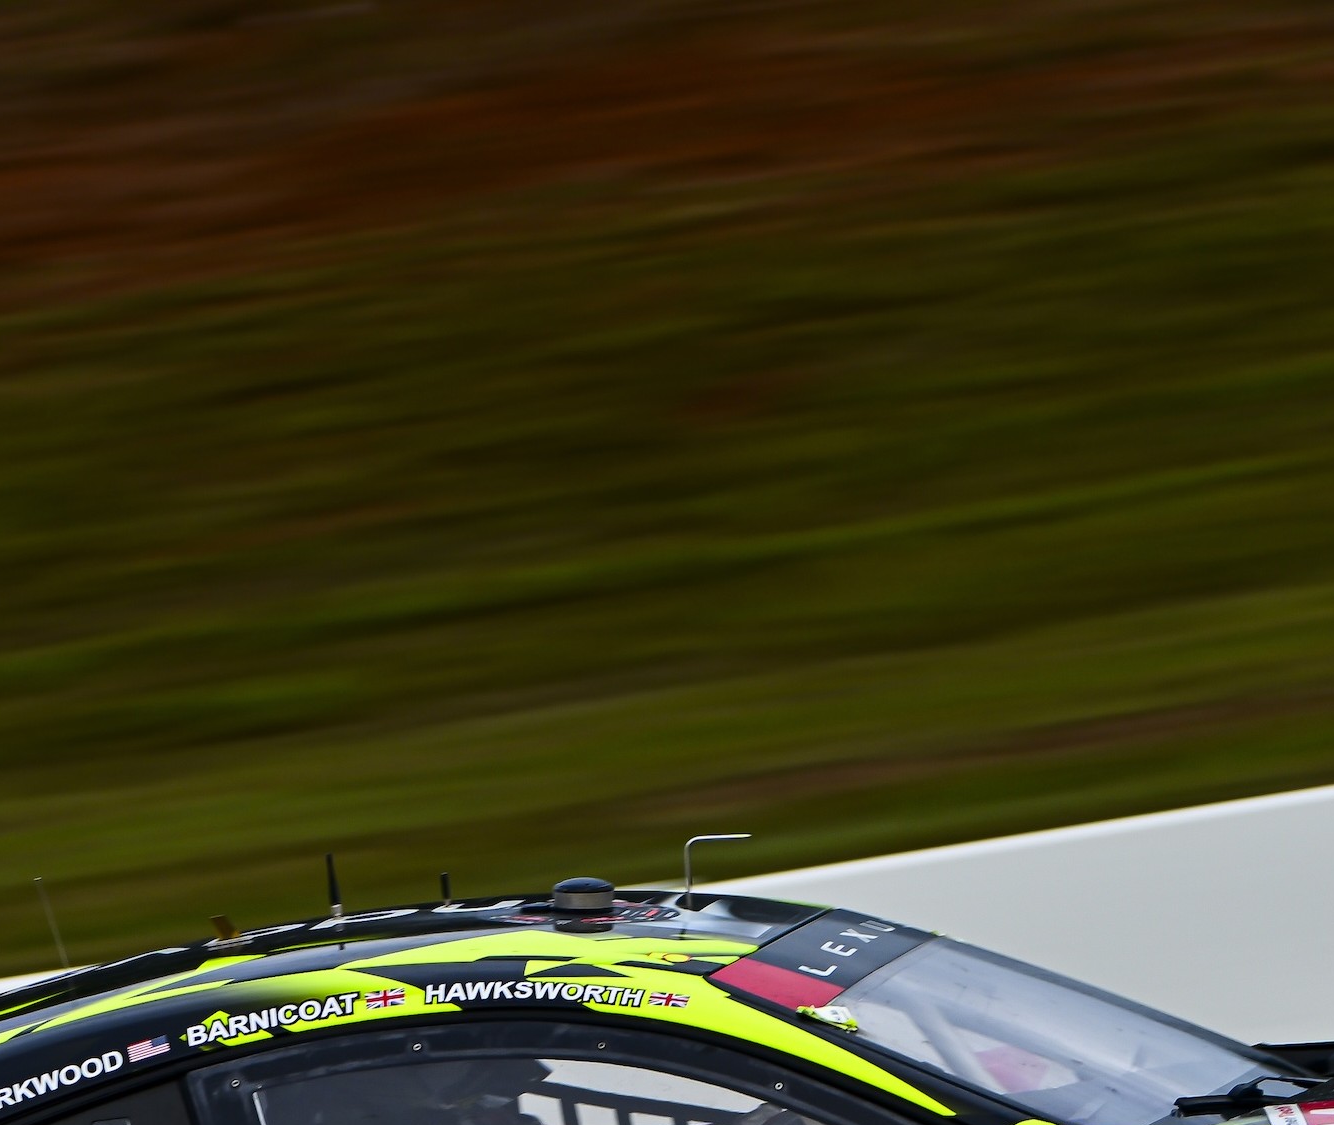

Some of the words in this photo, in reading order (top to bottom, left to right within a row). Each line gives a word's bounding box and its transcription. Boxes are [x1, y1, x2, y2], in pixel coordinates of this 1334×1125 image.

[798, 920, 896, 977] LEXU
[186, 993, 360, 1047] BARNICOAT
[424, 981, 644, 1008] HAWKSWORTH
